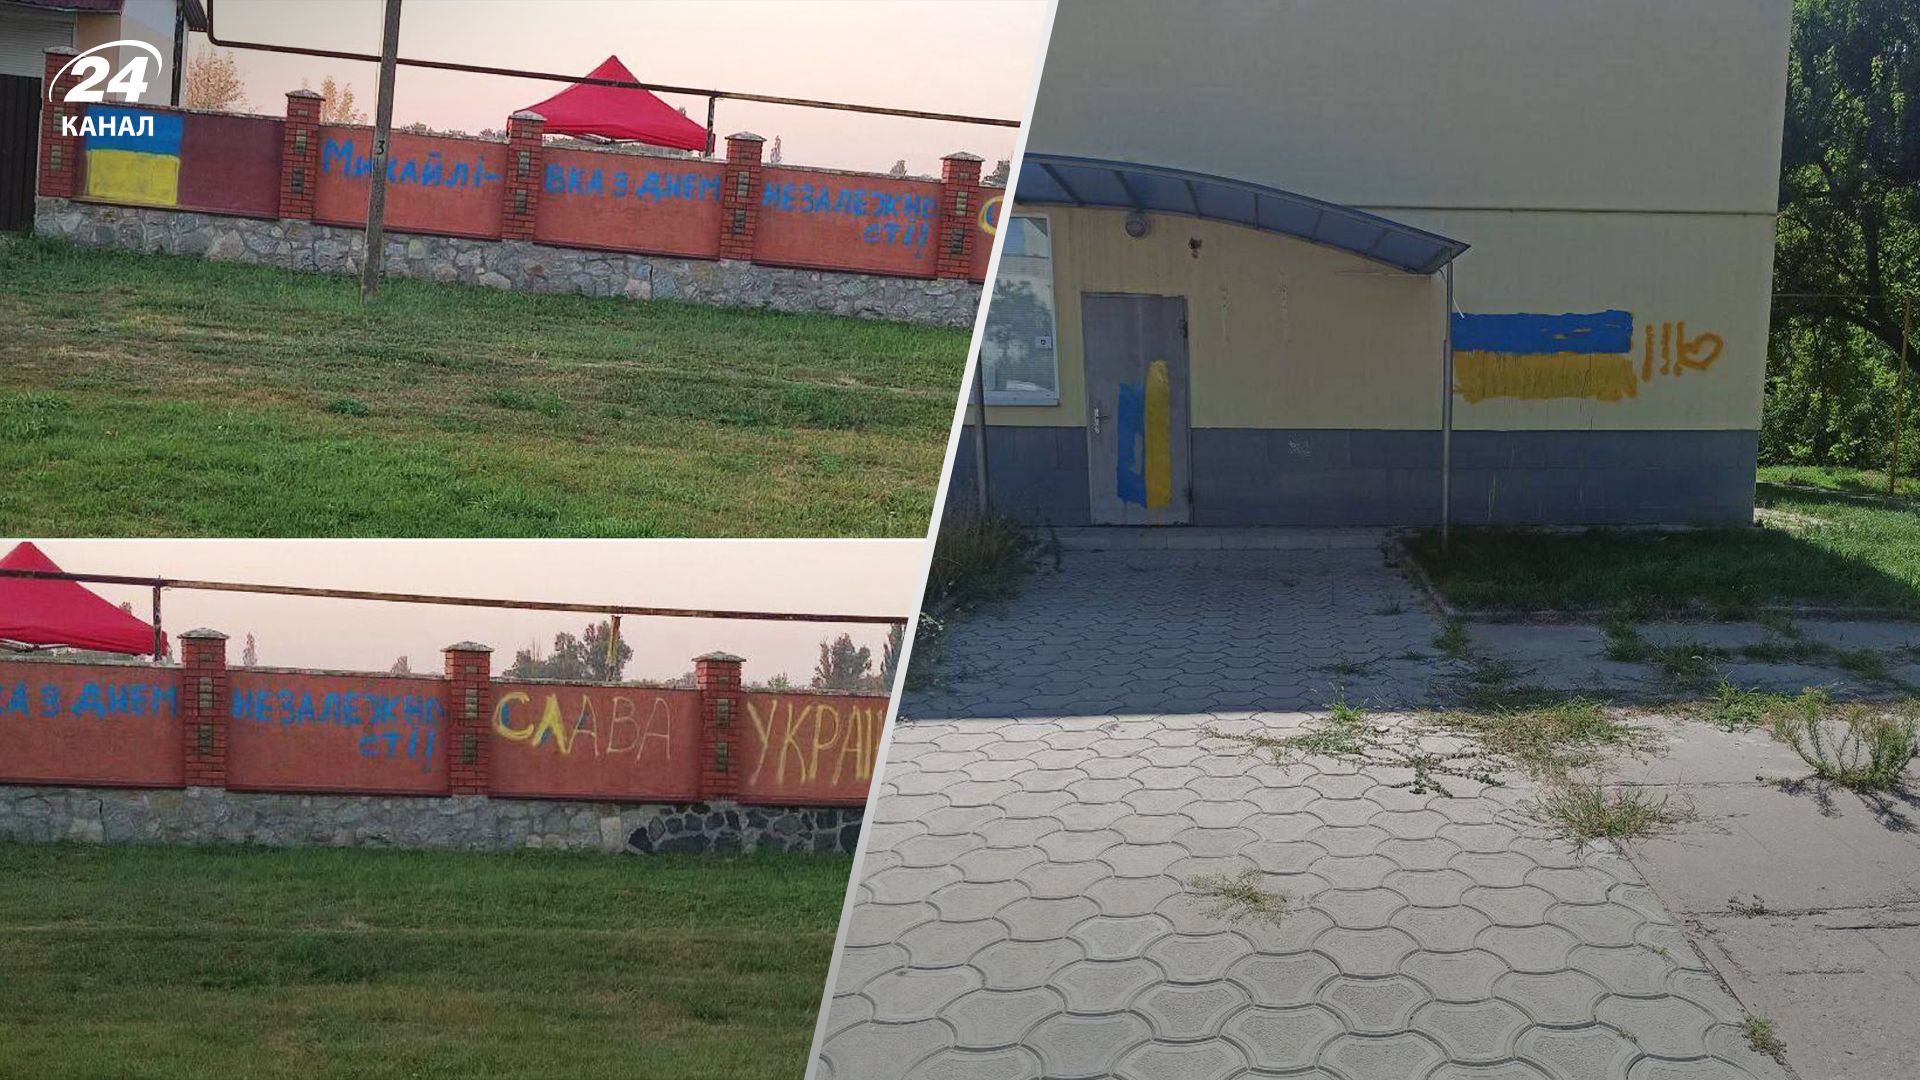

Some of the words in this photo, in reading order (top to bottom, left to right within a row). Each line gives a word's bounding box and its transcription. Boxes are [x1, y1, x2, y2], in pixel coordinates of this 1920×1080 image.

[376, 139, 386, 156] 3
[0, 680, 30, 716] А
[493, 691, 671, 761] СЛАВА
